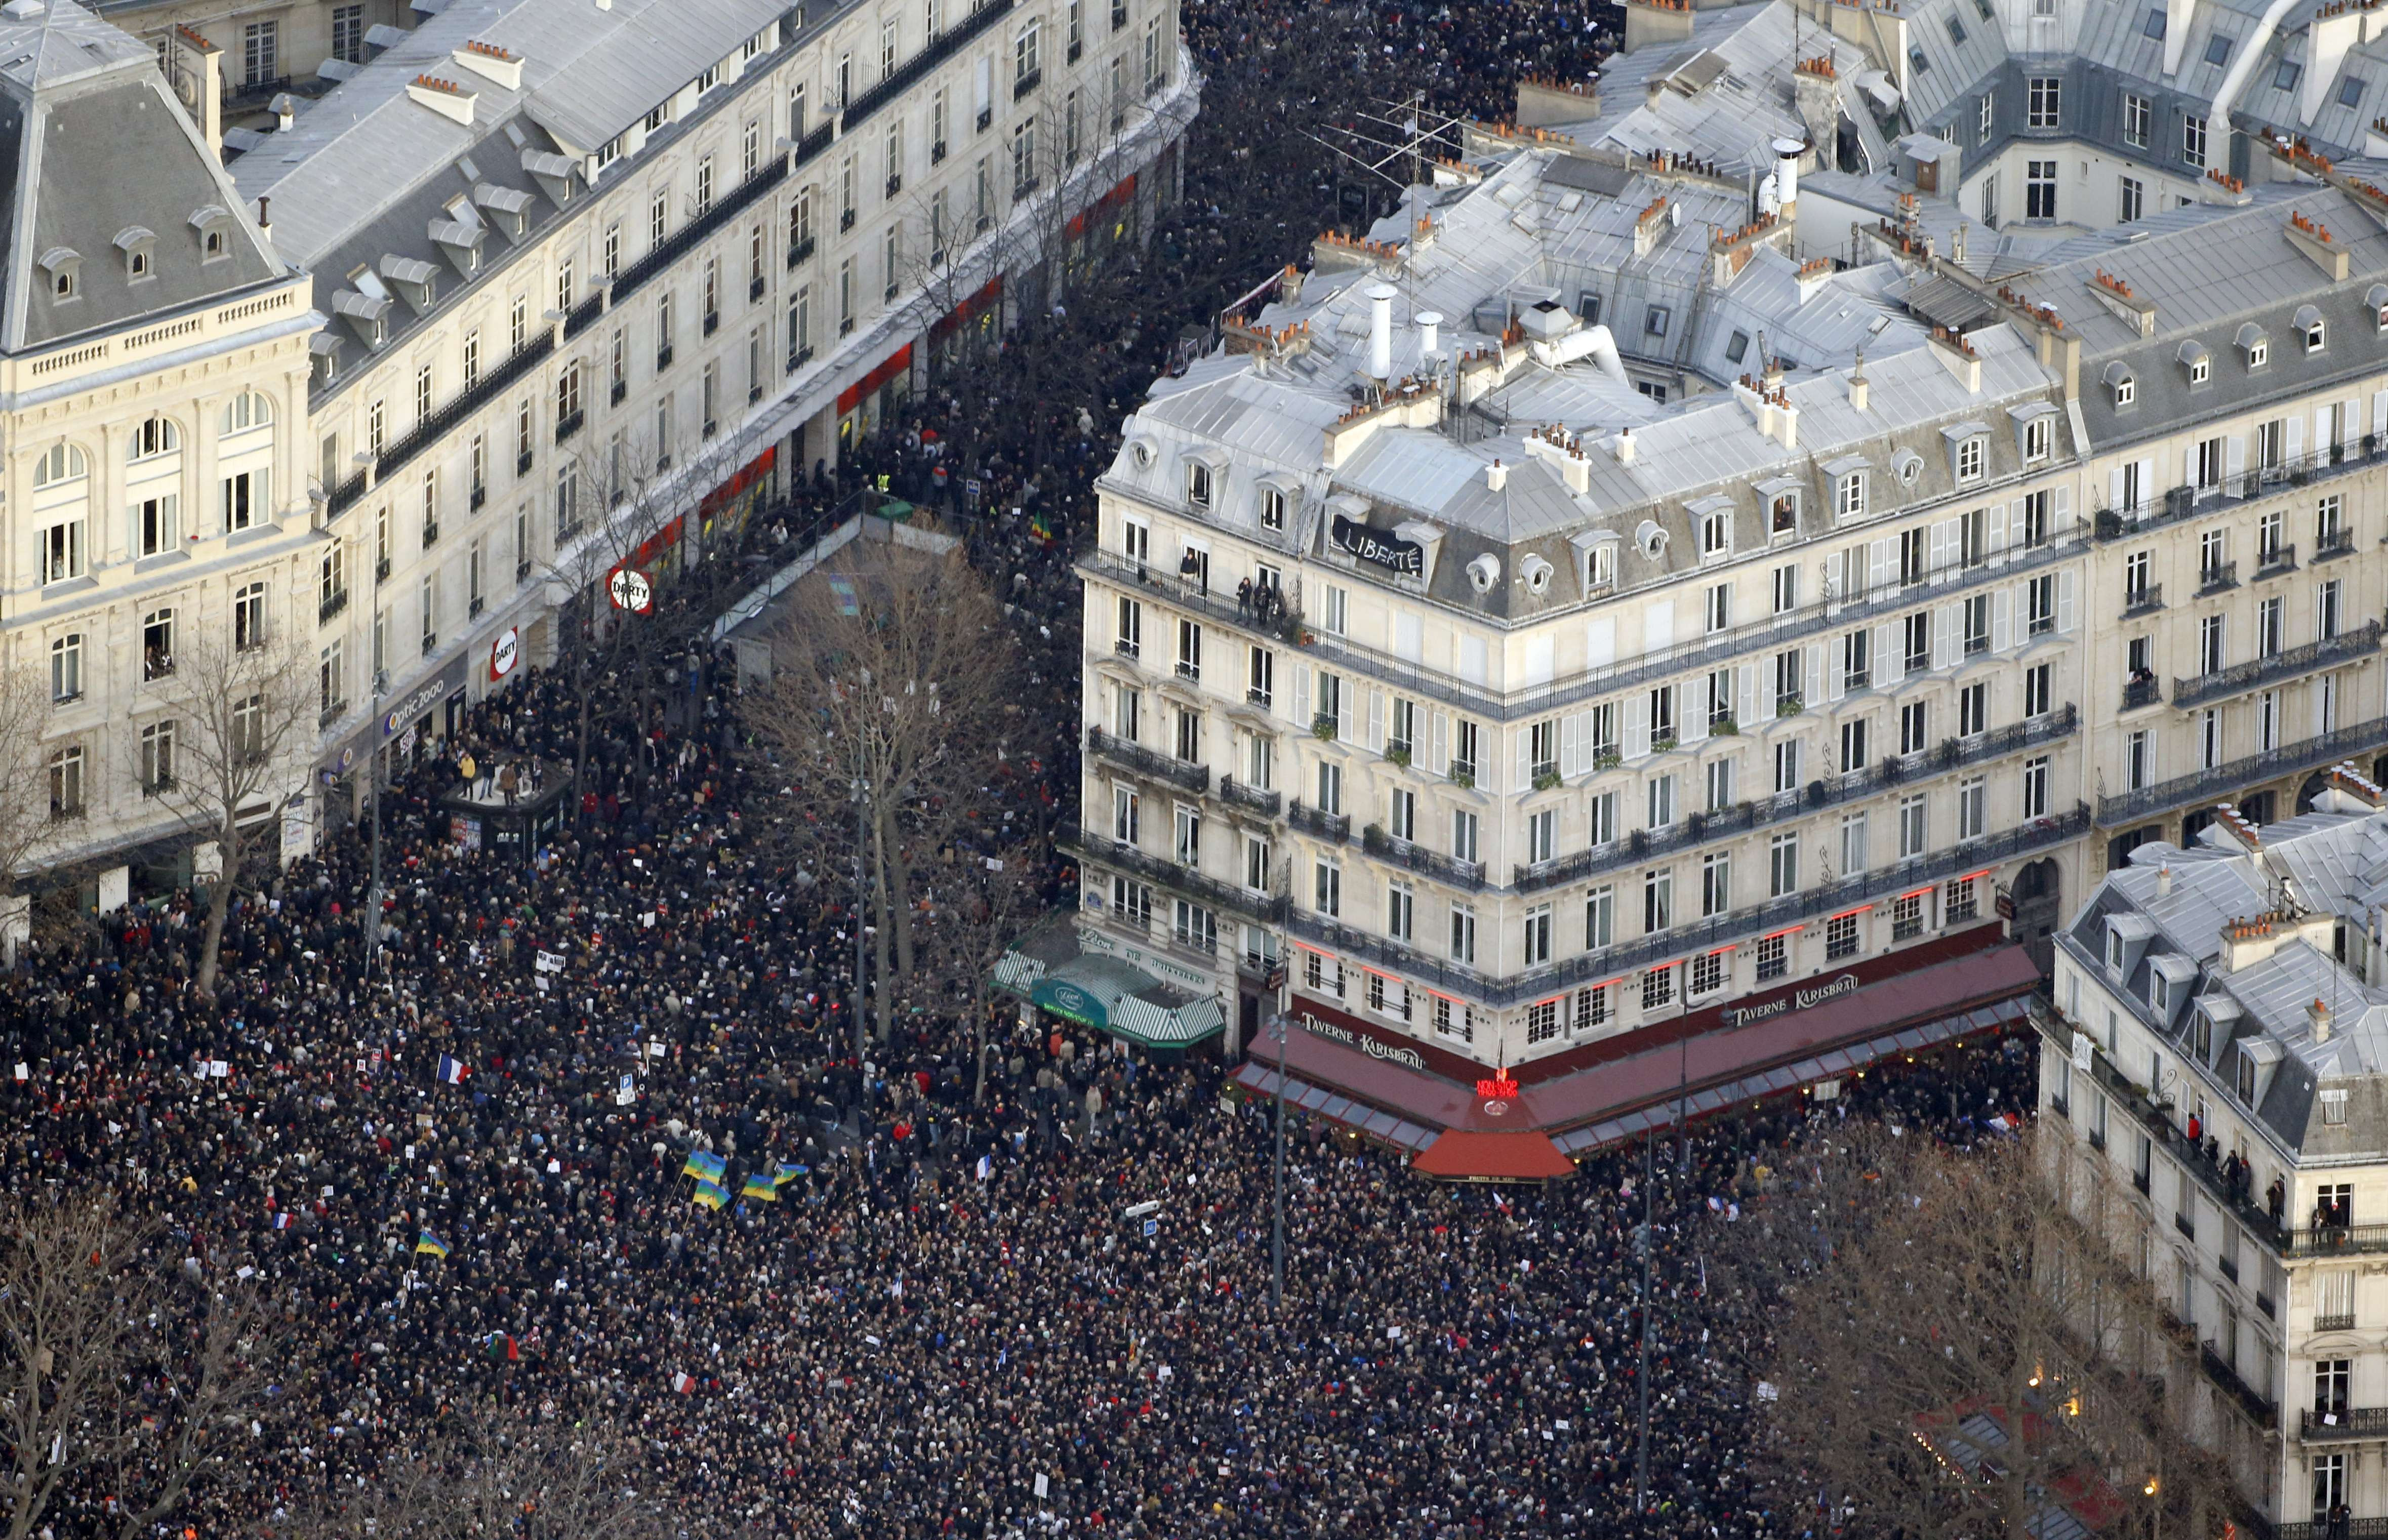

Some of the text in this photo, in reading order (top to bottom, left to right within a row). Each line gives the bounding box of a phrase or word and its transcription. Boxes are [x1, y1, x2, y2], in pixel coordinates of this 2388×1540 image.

[1345, 528, 1420, 570] LIBERTÉ
[496, 639, 516, 664] DARTY
[389, 698, 418, 730] Optic
[418, 679, 444, 707] 2000
[1150, 958, 1205, 985] BRUXELLES
[1733, 973, 1858, 1027] TAVERNE KARLSBRÄU
[1302, 1011, 1424, 1070] TAVERNE KARLSBRÄU
[623, 1077, 629, 1088] P
[1477, 1080, 1518, 1090] NON-STOP
